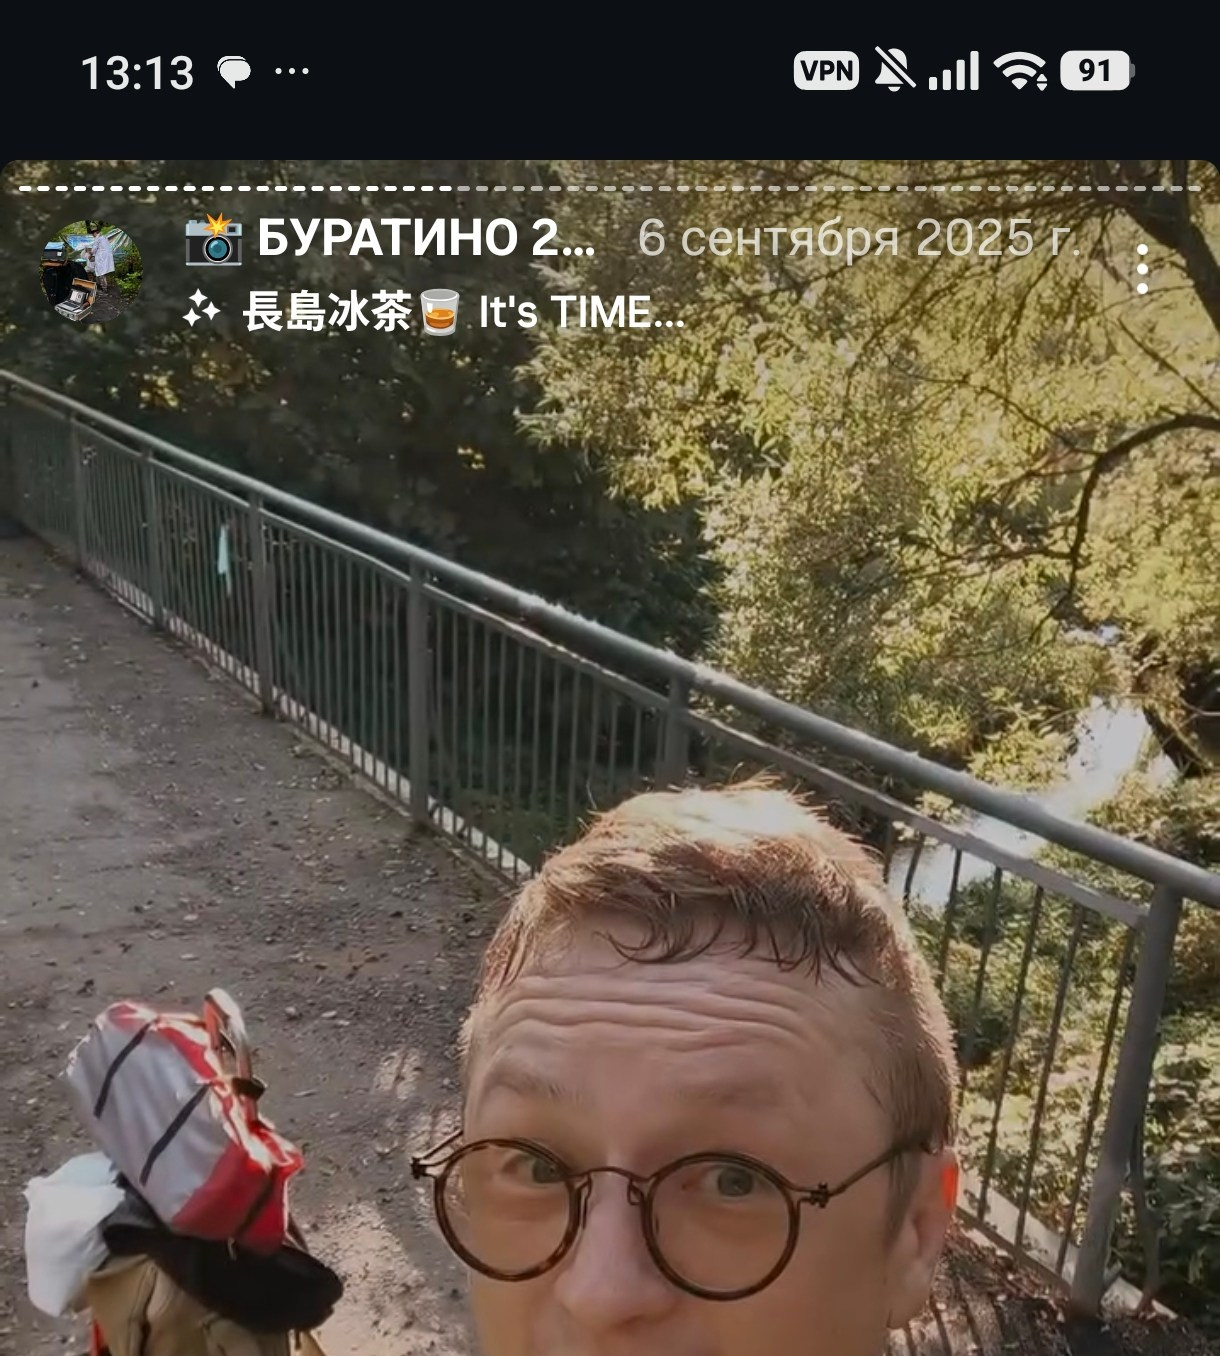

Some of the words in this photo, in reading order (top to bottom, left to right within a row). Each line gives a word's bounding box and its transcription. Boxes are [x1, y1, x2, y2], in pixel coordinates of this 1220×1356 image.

[82, 55, 194, 91] 13:13
[799, 59, 854, 82] VPN
[1078, 58, 1111, 82] 91
